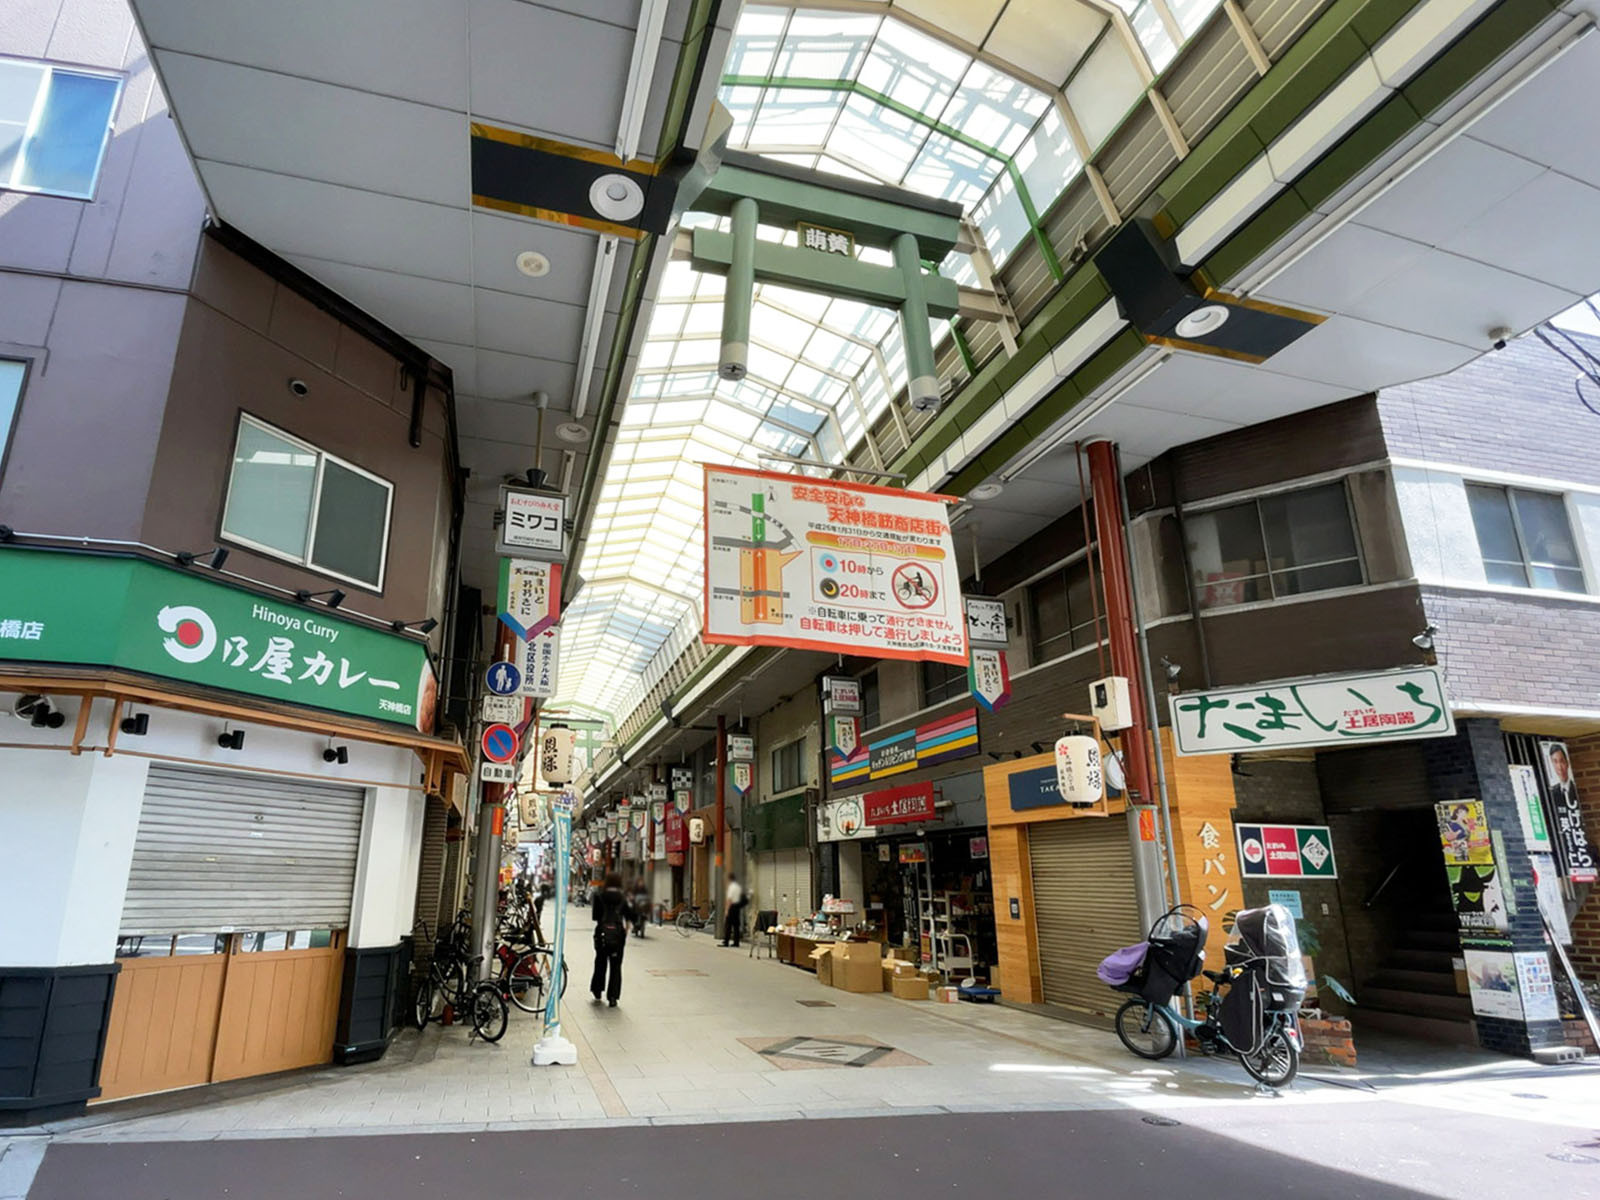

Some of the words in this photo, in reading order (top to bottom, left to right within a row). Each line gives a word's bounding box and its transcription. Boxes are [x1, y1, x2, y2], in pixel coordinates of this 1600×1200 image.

[792, 486, 865, 507] 安全安心な
[511, 511, 558, 532] ミワコ
[828, 506, 952, 537] 天神橋筋商店街へ
[839, 560, 884, 576] 10時から
[840, 583, 886, 601] 20時まで
[0, 619, 44, 640] 橋店
[252, 604, 301, 631] Hinoya
[304, 619, 339, 643] Curry
[800, 617, 963, 646] 自転車は押して通行しましょう
[525, 641, 536, 686] 北区役所
[1345, 711, 1416, 729] 土居陶器
[483, 765, 513, 779] 自動車
[1199, 821, 1230, 911] 食パン
